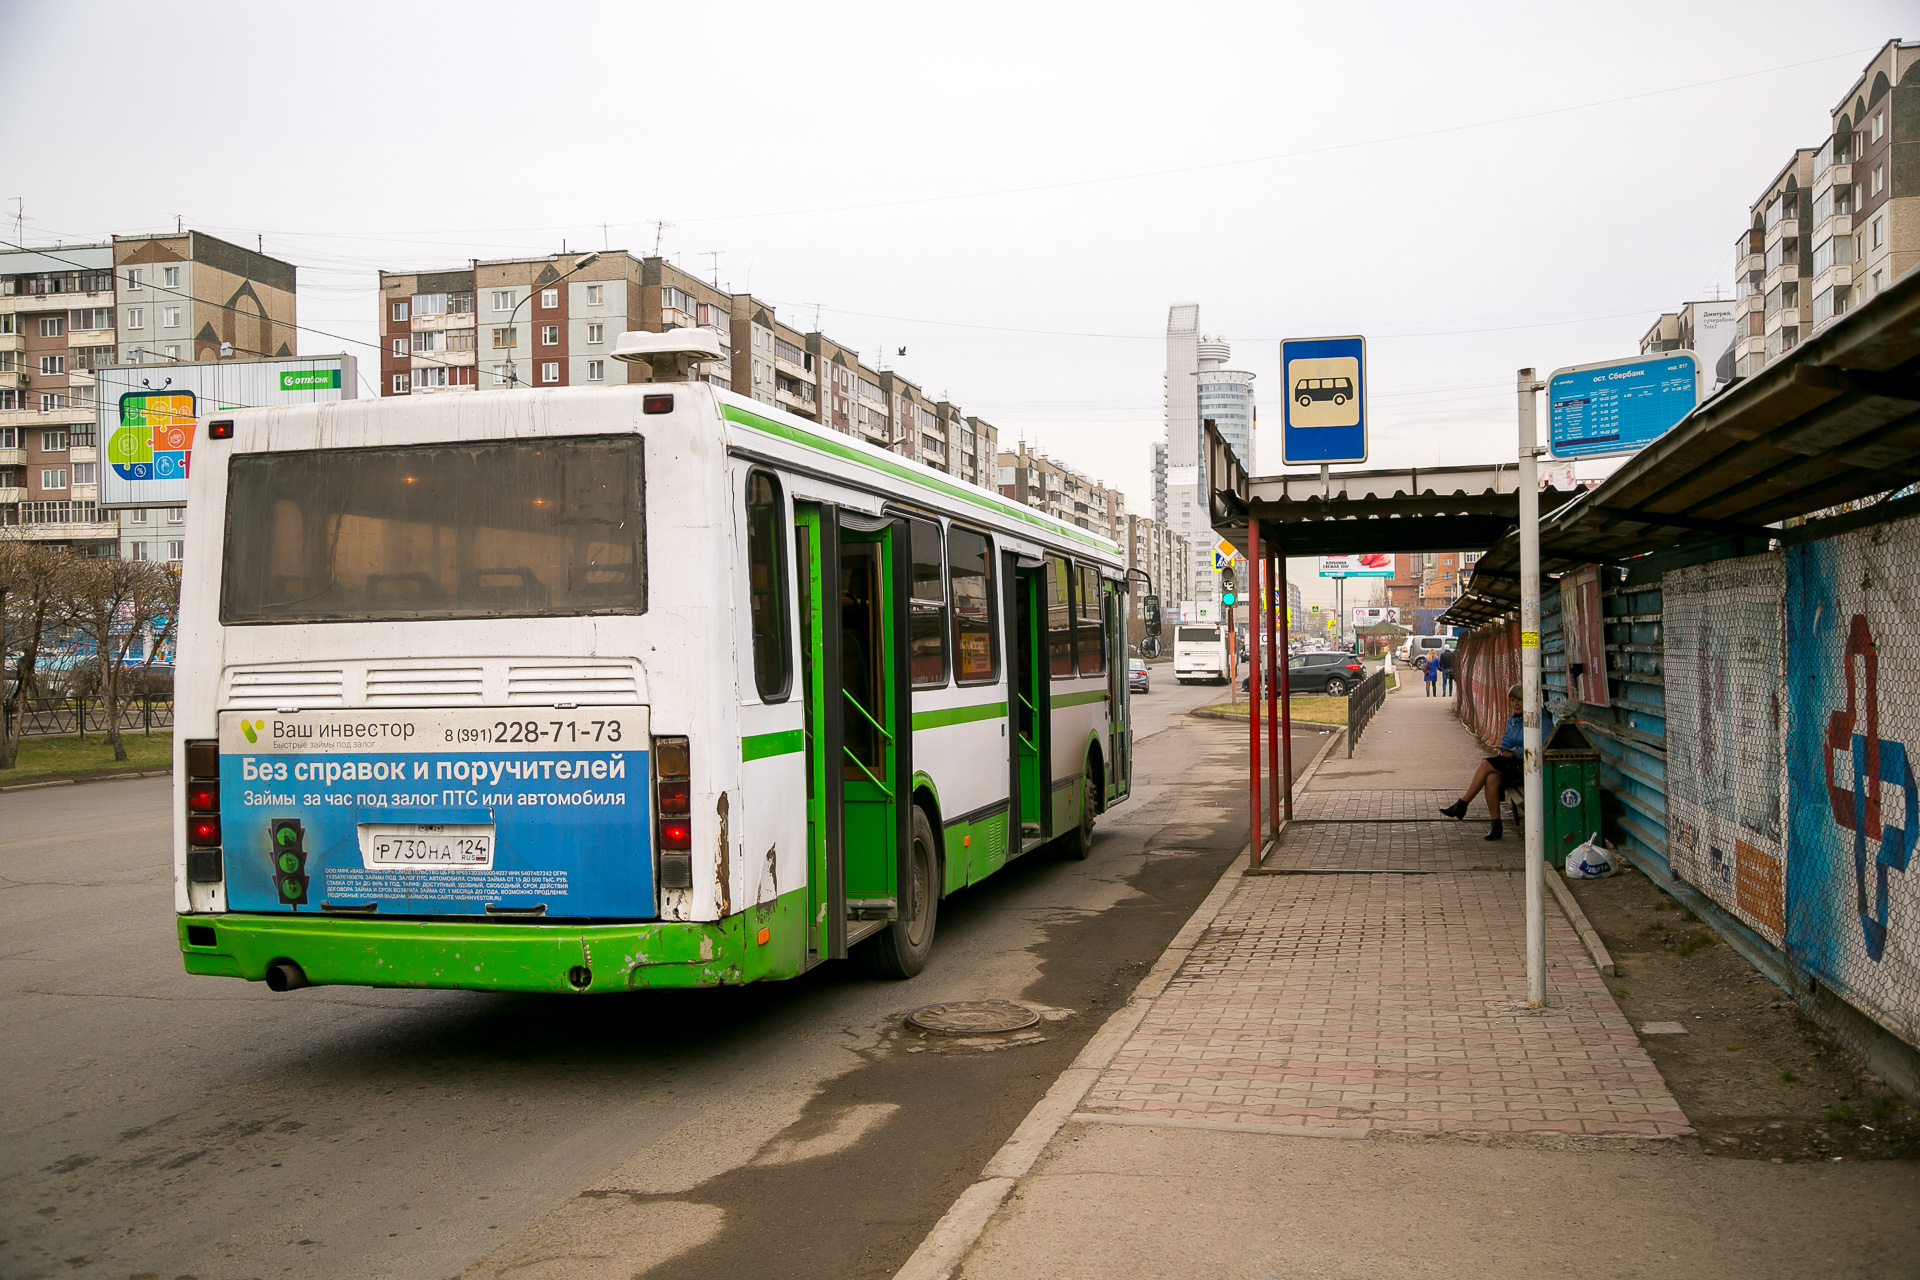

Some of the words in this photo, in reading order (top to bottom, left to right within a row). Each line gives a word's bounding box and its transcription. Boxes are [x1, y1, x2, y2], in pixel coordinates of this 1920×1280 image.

[1608, 370, 1644, 380] Сбербанк
[1224, 581, 1234, 591] 42
[273, 721, 312, 738] Ваш
[319, 723, 415, 741] инвестор
[445, 729, 453, 742] 8
[457, 728, 492, 743] (391)
[494, 720, 622, 743] 228-71-73
[273, 741, 308, 749] Быстрые
[310, 740, 335, 749] займы
[242, 757, 288, 781] Без
[294, 761, 406, 786] справок
[414, 761, 429, 780] и
[436, 753, 625, 786] поручителей
[244, 790, 296, 806] Займы
[303, 793, 321, 806] за
[324, 793, 352, 806] час
[356, 793, 387, 808] под
[391, 793, 438, 807] залог
[442, 790, 478, 806] ПТС
[482, 793, 513, 806] или
[517, 790, 626, 806] автомобиля
[457, 840, 483, 854] 124
